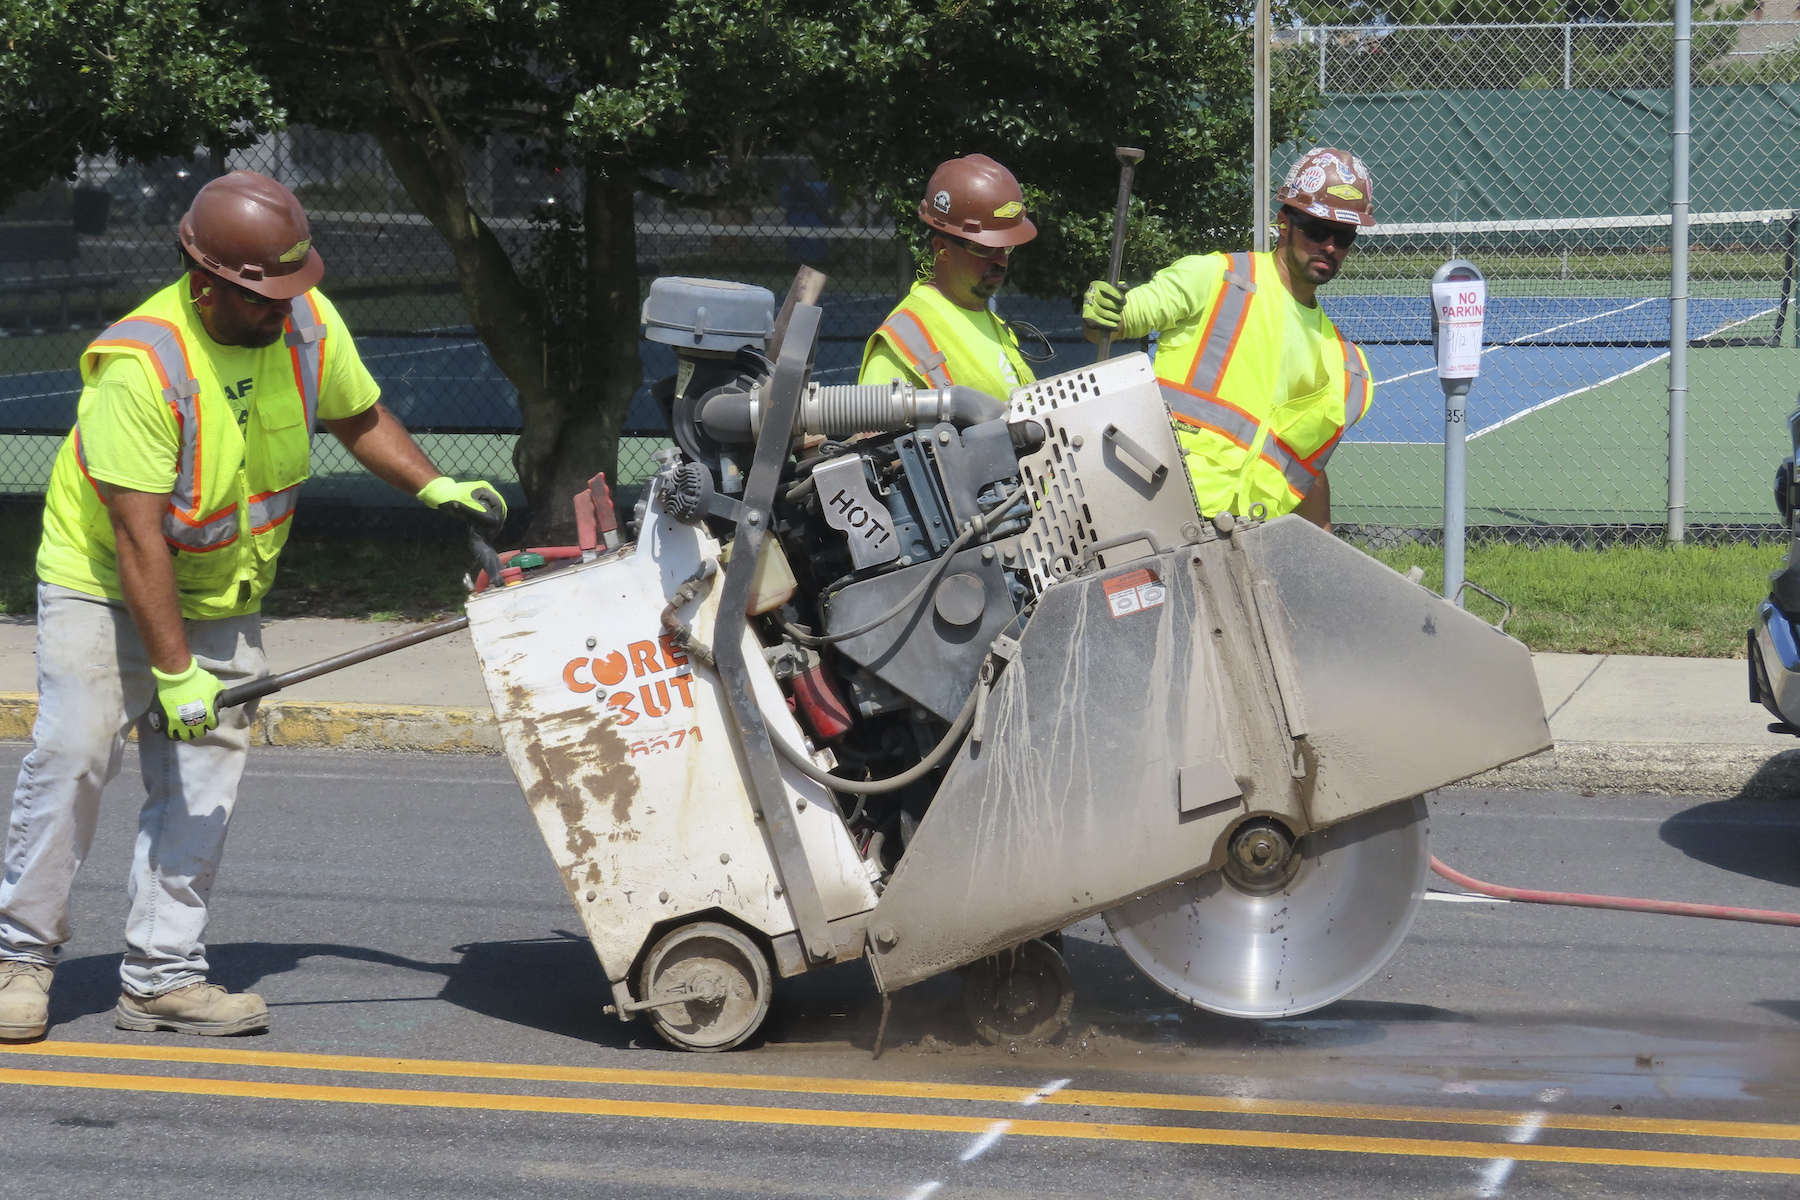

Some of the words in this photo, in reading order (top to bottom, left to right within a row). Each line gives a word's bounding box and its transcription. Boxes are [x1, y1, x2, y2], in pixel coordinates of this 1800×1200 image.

[1459, 292, 1476, 305] NO
[829, 489, 890, 549] HOT!
[562, 633, 689, 694] CORE
